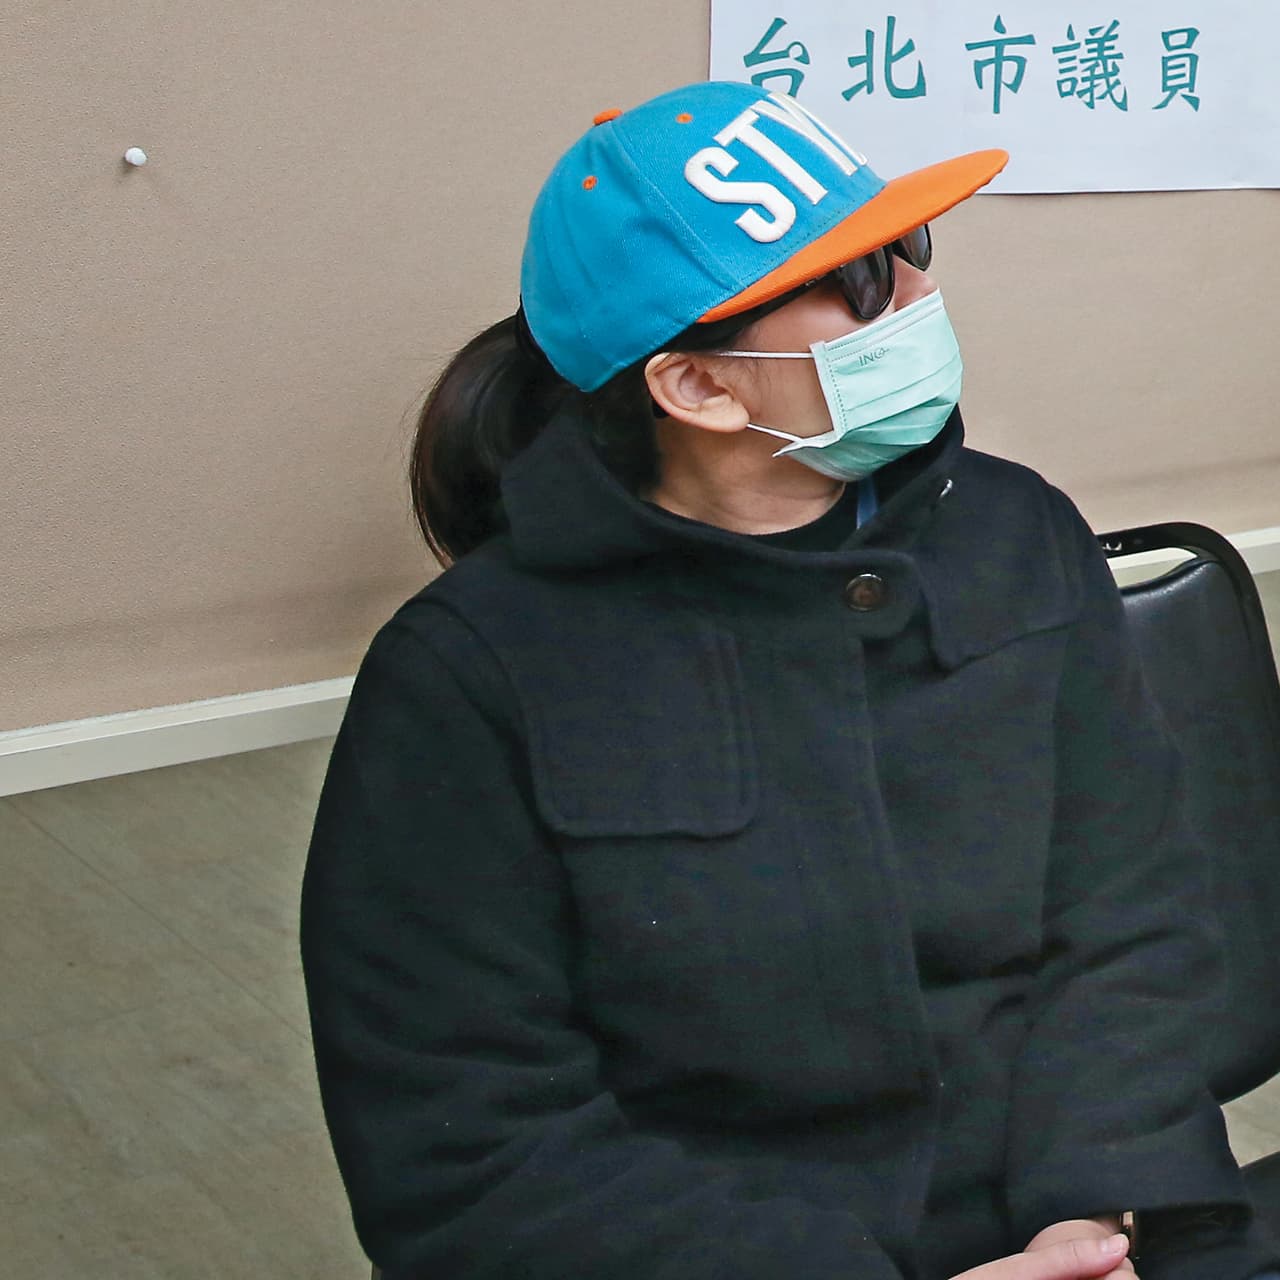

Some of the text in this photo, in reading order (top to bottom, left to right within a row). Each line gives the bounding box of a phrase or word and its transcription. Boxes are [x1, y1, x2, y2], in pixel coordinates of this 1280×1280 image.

[743, 16, 1201, 115] 台北市議員
